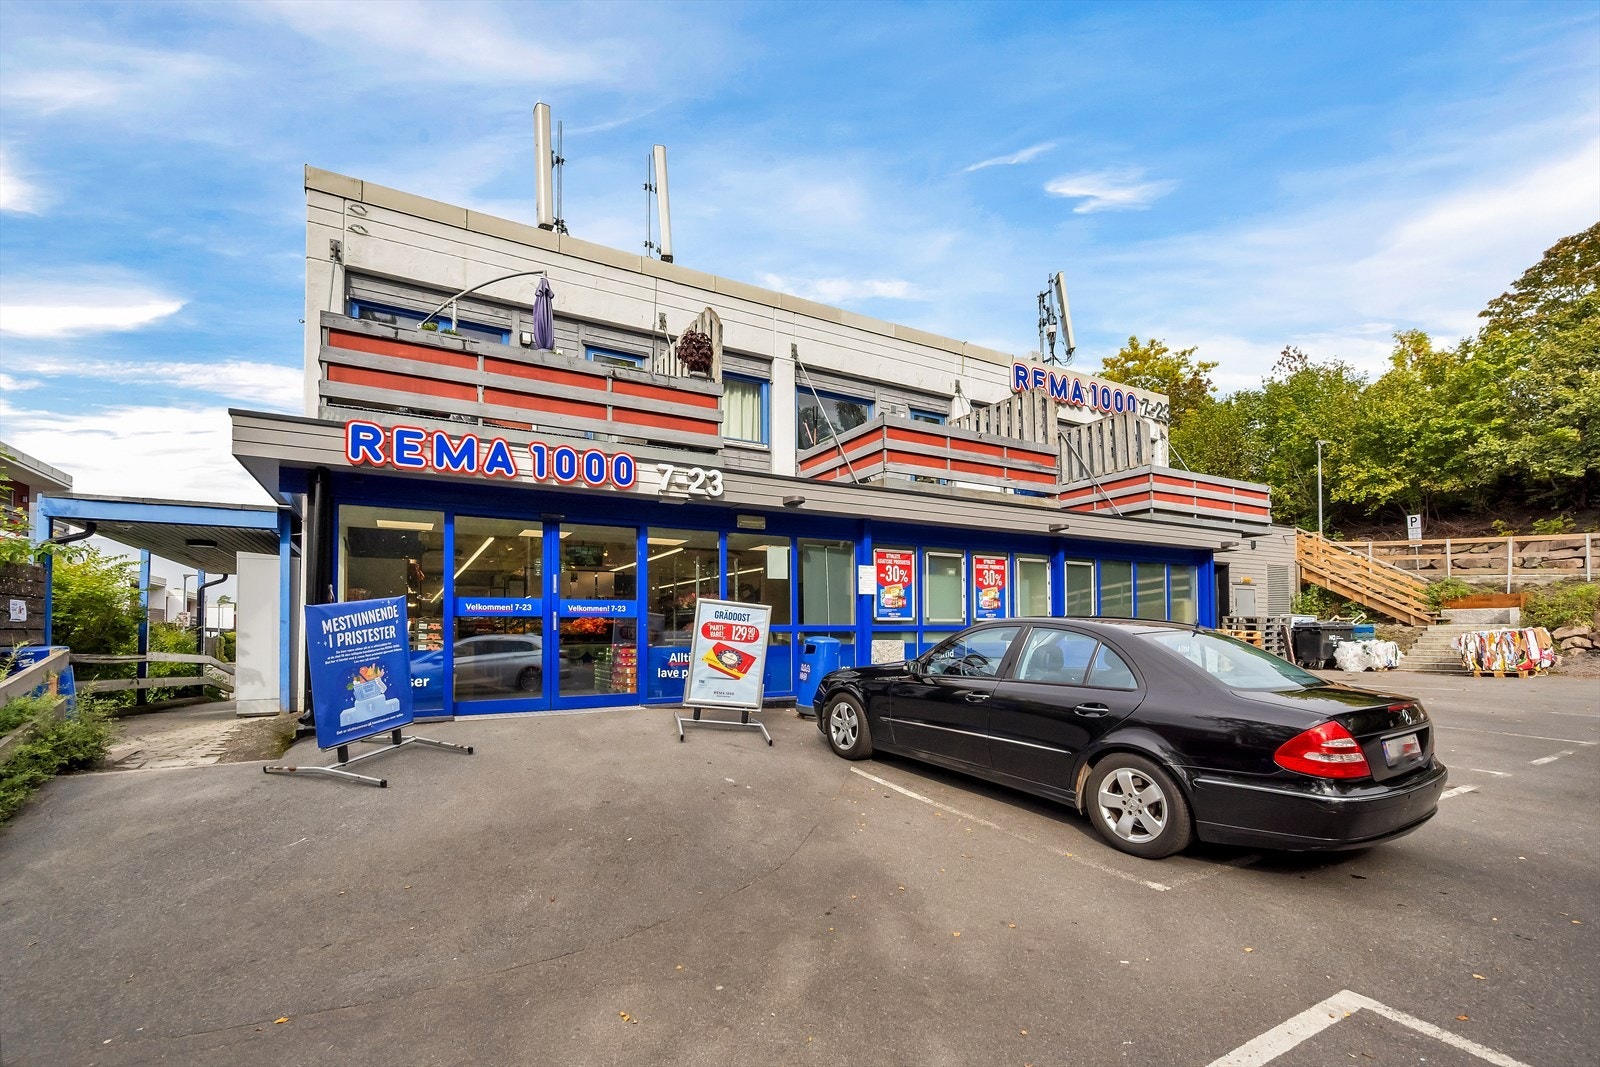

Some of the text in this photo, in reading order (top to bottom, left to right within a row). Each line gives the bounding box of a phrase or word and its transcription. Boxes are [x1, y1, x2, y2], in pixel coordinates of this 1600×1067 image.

[1013, 362, 1085, 407] REMA
[1089, 381, 1137, 413] 1000
[345, 419, 724, 498] REMA 1000 7-23
[1410, 516, 1418, 527] P
[879, 564, 909, 583] -30%
[978, 569, 1003, 586] -30%
[465, 603, 532, 611] Velkommen! 7-23
[568, 604, 610, 612] Velkommen!
[321, 604, 399, 635] MESTVINNENDE
[714, 609, 751, 622] GRÄDDOST
[328, 633, 334, 649] I
[336, 625, 397, 647] PRISTESTER
[731, 625, 747, 641] 129
[657, 667, 679, 678] lave
